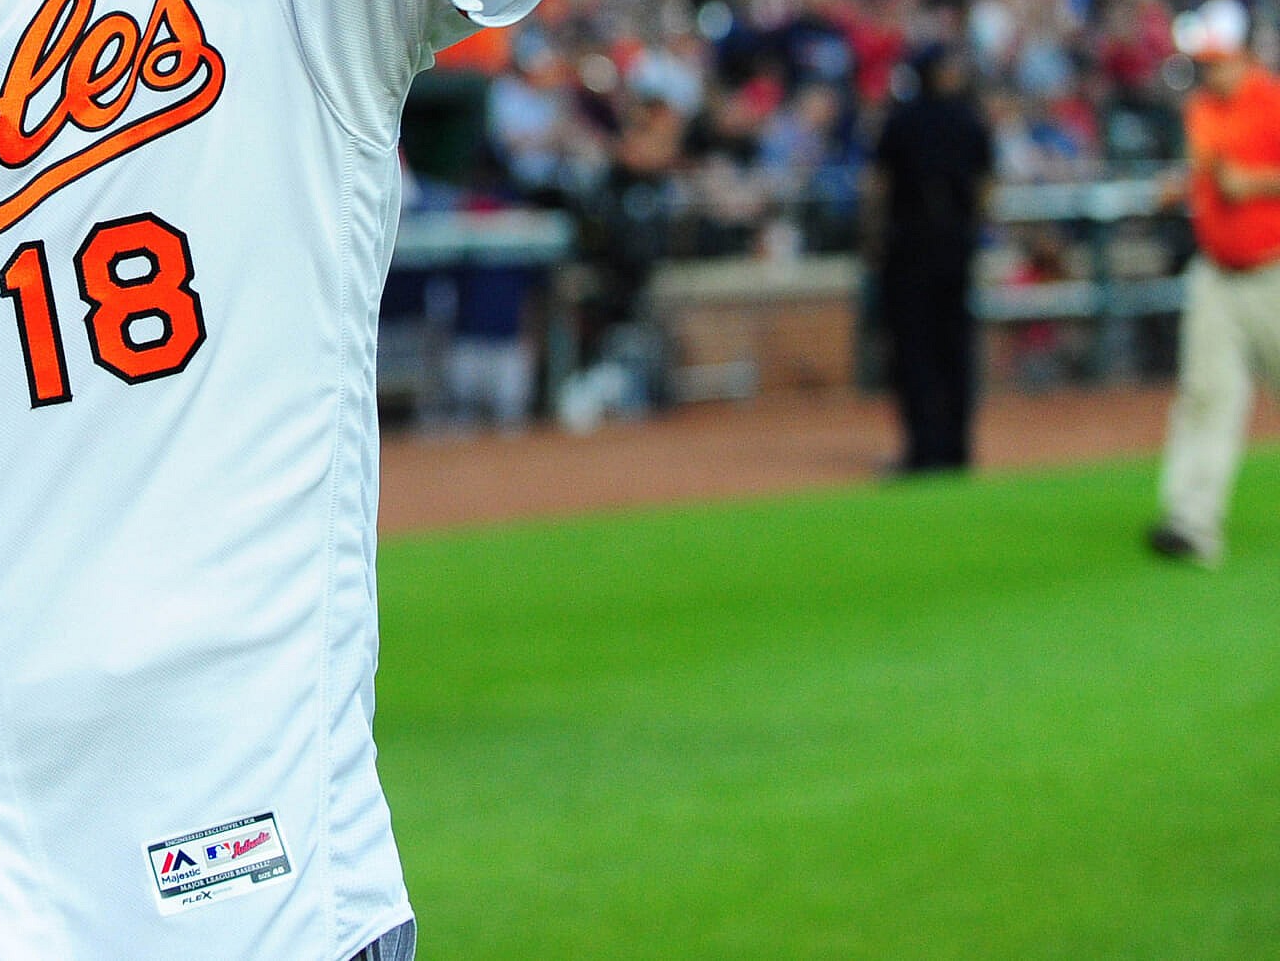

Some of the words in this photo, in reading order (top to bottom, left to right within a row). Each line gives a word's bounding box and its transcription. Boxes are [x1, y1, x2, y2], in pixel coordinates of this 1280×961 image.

[0, 212, 207, 409] 18
[162, 868, 201, 886] Majestic
[180, 880, 205, 891] MAJOR
